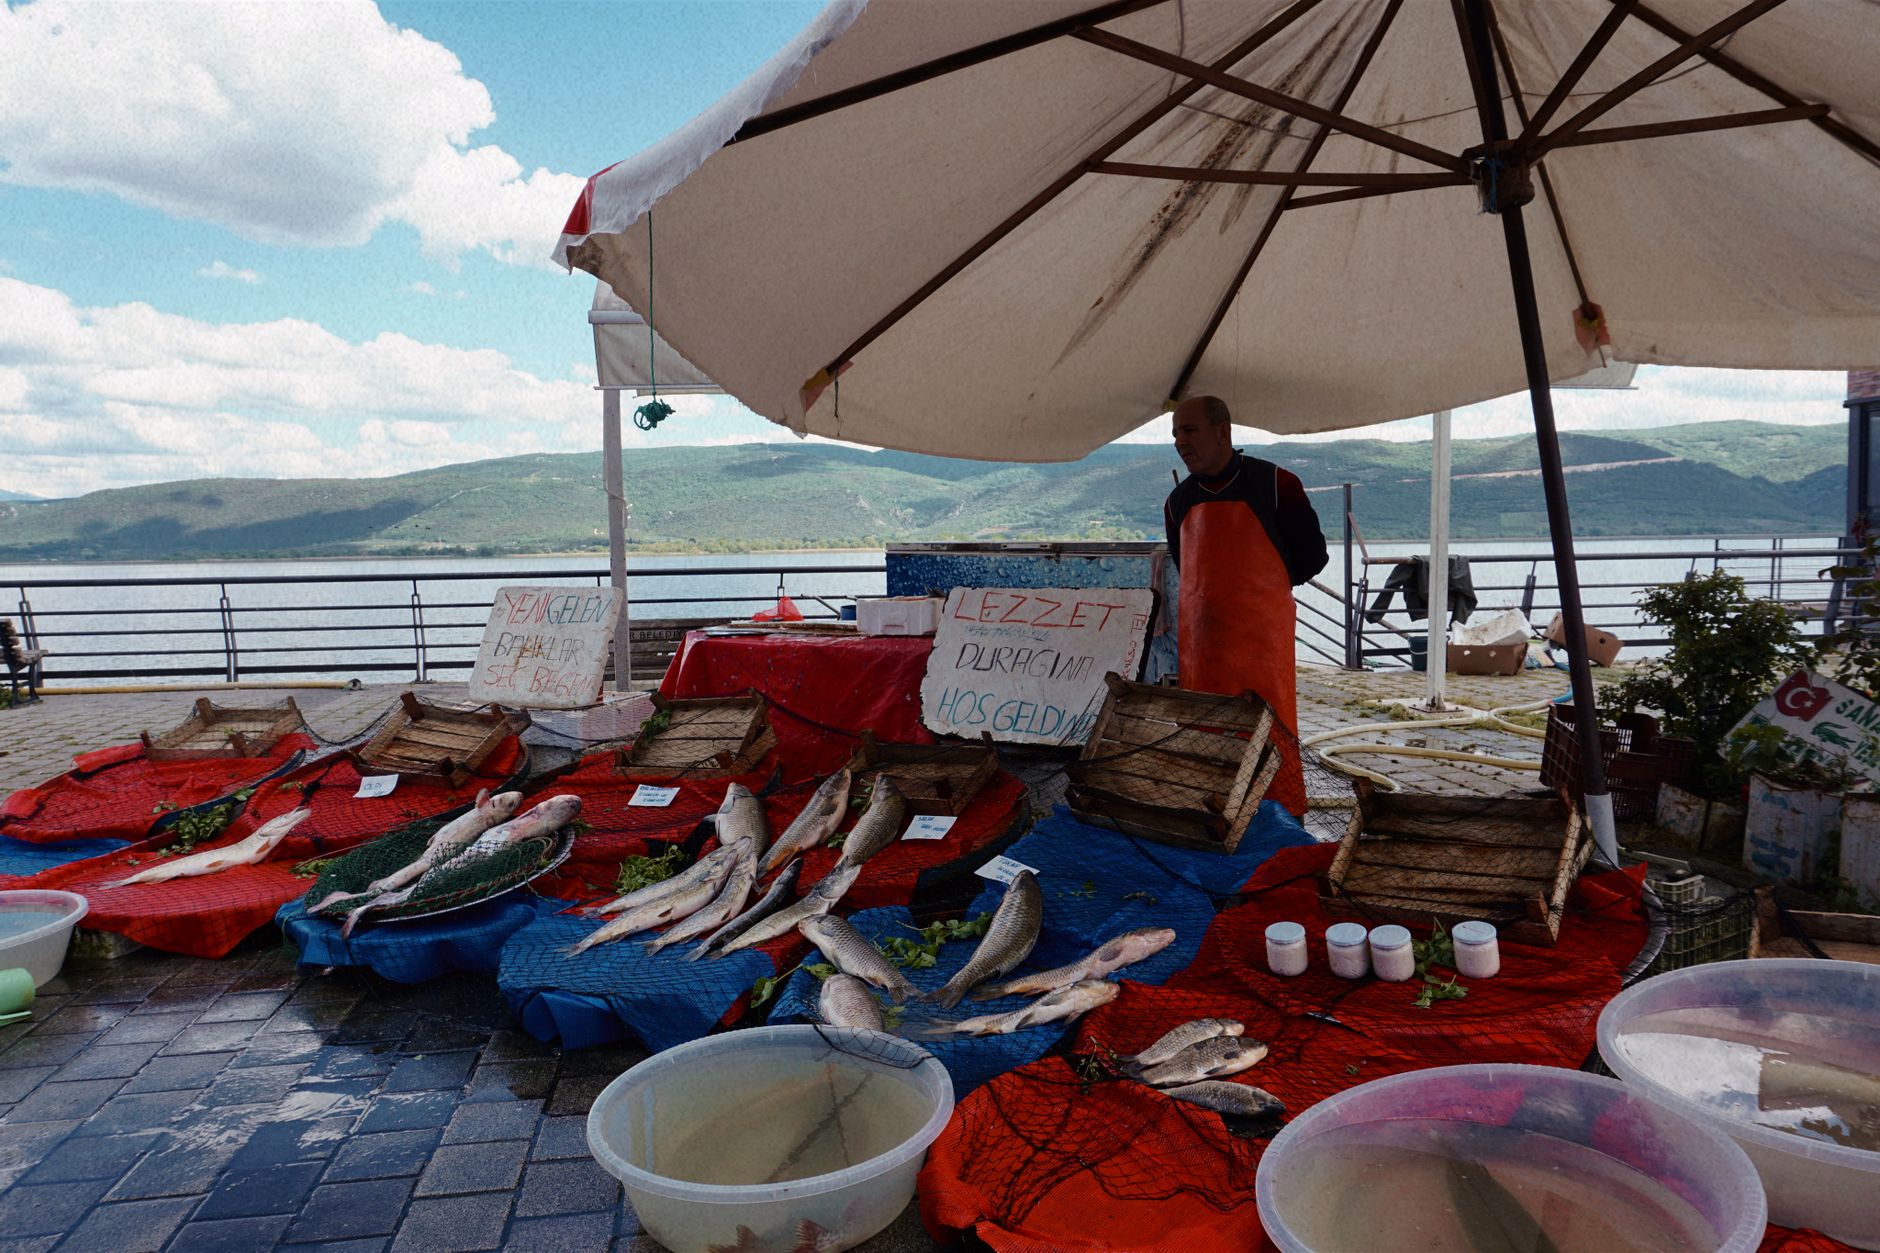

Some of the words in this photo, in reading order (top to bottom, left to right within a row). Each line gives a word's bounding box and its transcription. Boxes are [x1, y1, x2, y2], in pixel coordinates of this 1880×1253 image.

[547, 594, 612, 625] GELEN
[954, 591, 1126, 631] LEZZET
[494, 632, 585, 666] BALIKLAR
